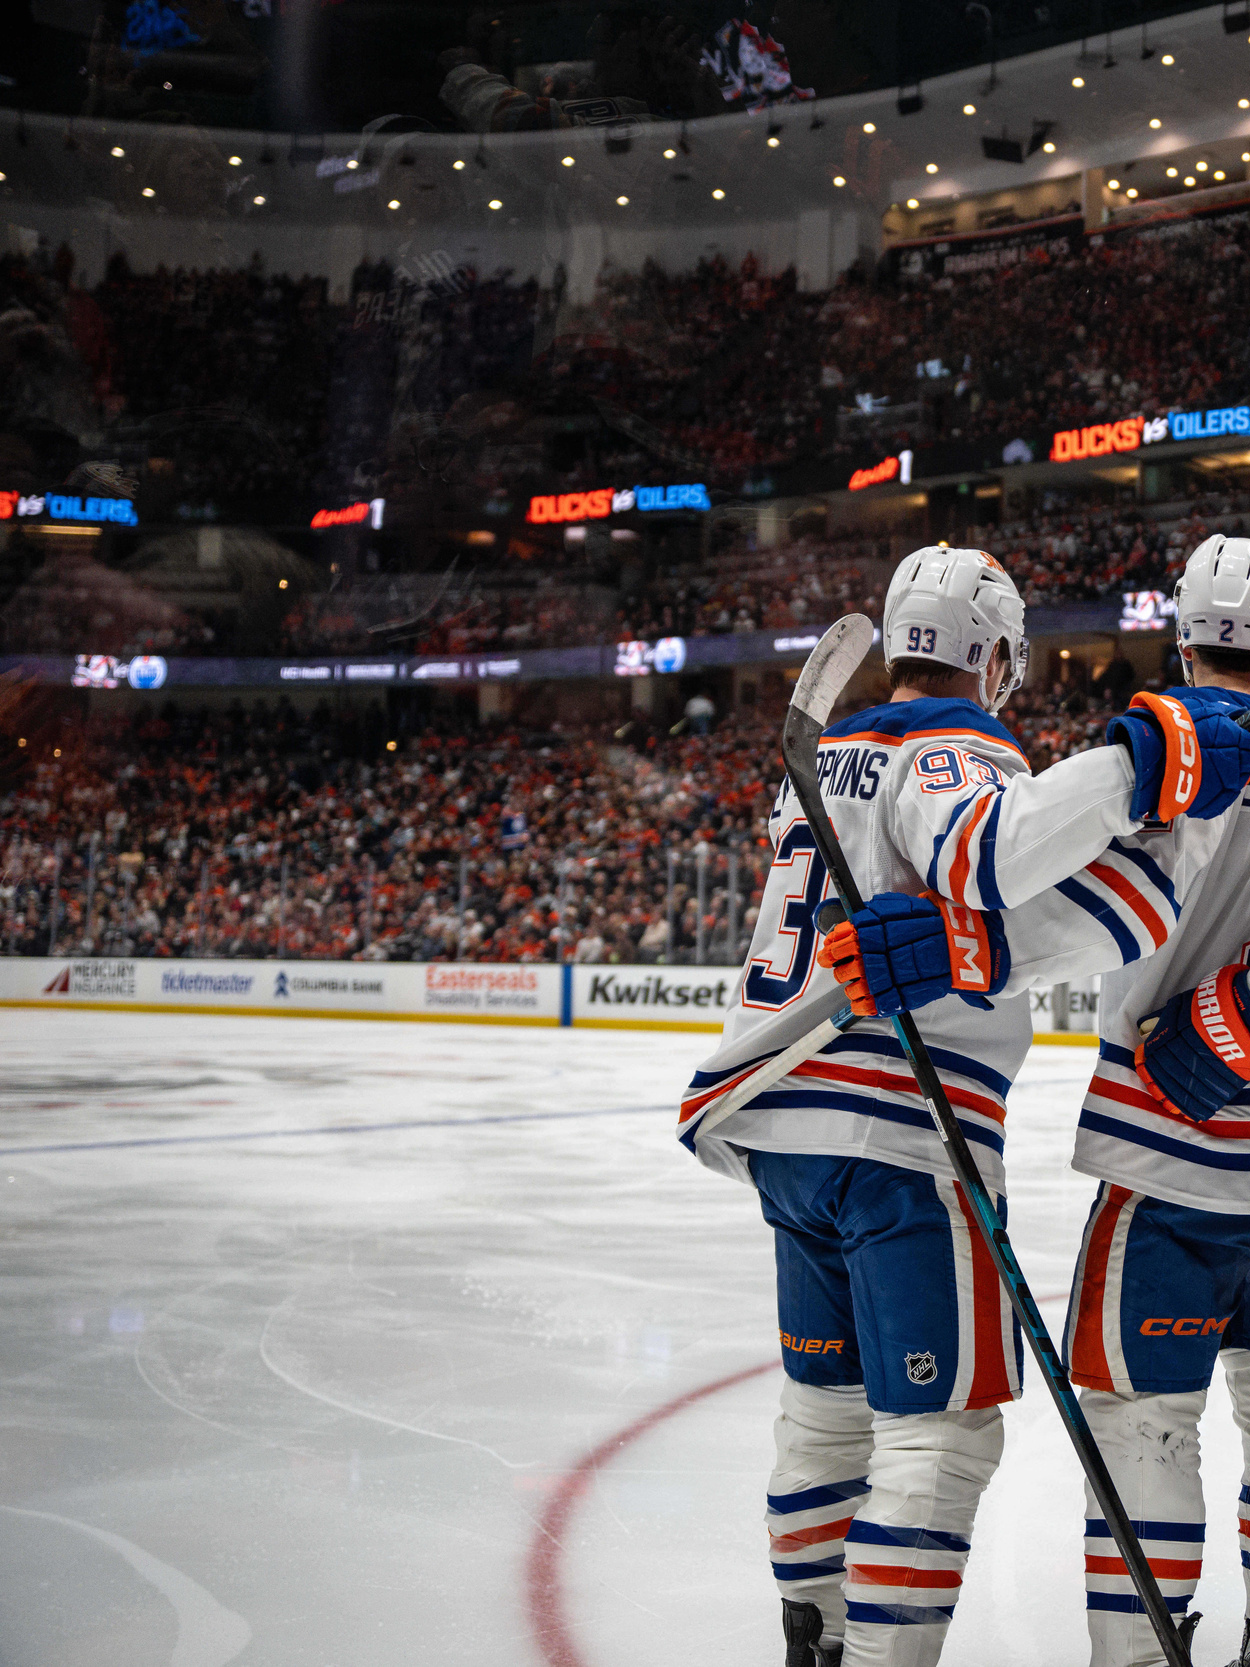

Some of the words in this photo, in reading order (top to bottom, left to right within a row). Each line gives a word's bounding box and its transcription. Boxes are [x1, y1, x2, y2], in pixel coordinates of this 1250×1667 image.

[1053, 420, 1140, 462] DUCKS
[1173, 406, 1250, 440] OILERS
[900, 450, 914, 485] 1
[906, 626, 937, 656] 93
[1218, 618, 1235, 644] 2
[1159, 697, 1197, 805] CCM
[945, 900, 985, 986] CM
[73, 962, 135, 979] MERCURY
[161, 969, 254, 994] ticketmaster
[425, 965, 538, 991] Easterseals
[291, 976, 348, 993] COLUMBIA
[352, 978, 384, 994] BANK
[588, 973, 728, 1007] Kwikset
[1200, 966, 1246, 1062] ARRIOR
[1138, 1317, 1232, 1336] CCM
[778, 1328, 846, 1354] AUER
[912, 1359, 932, 1380] NHL
